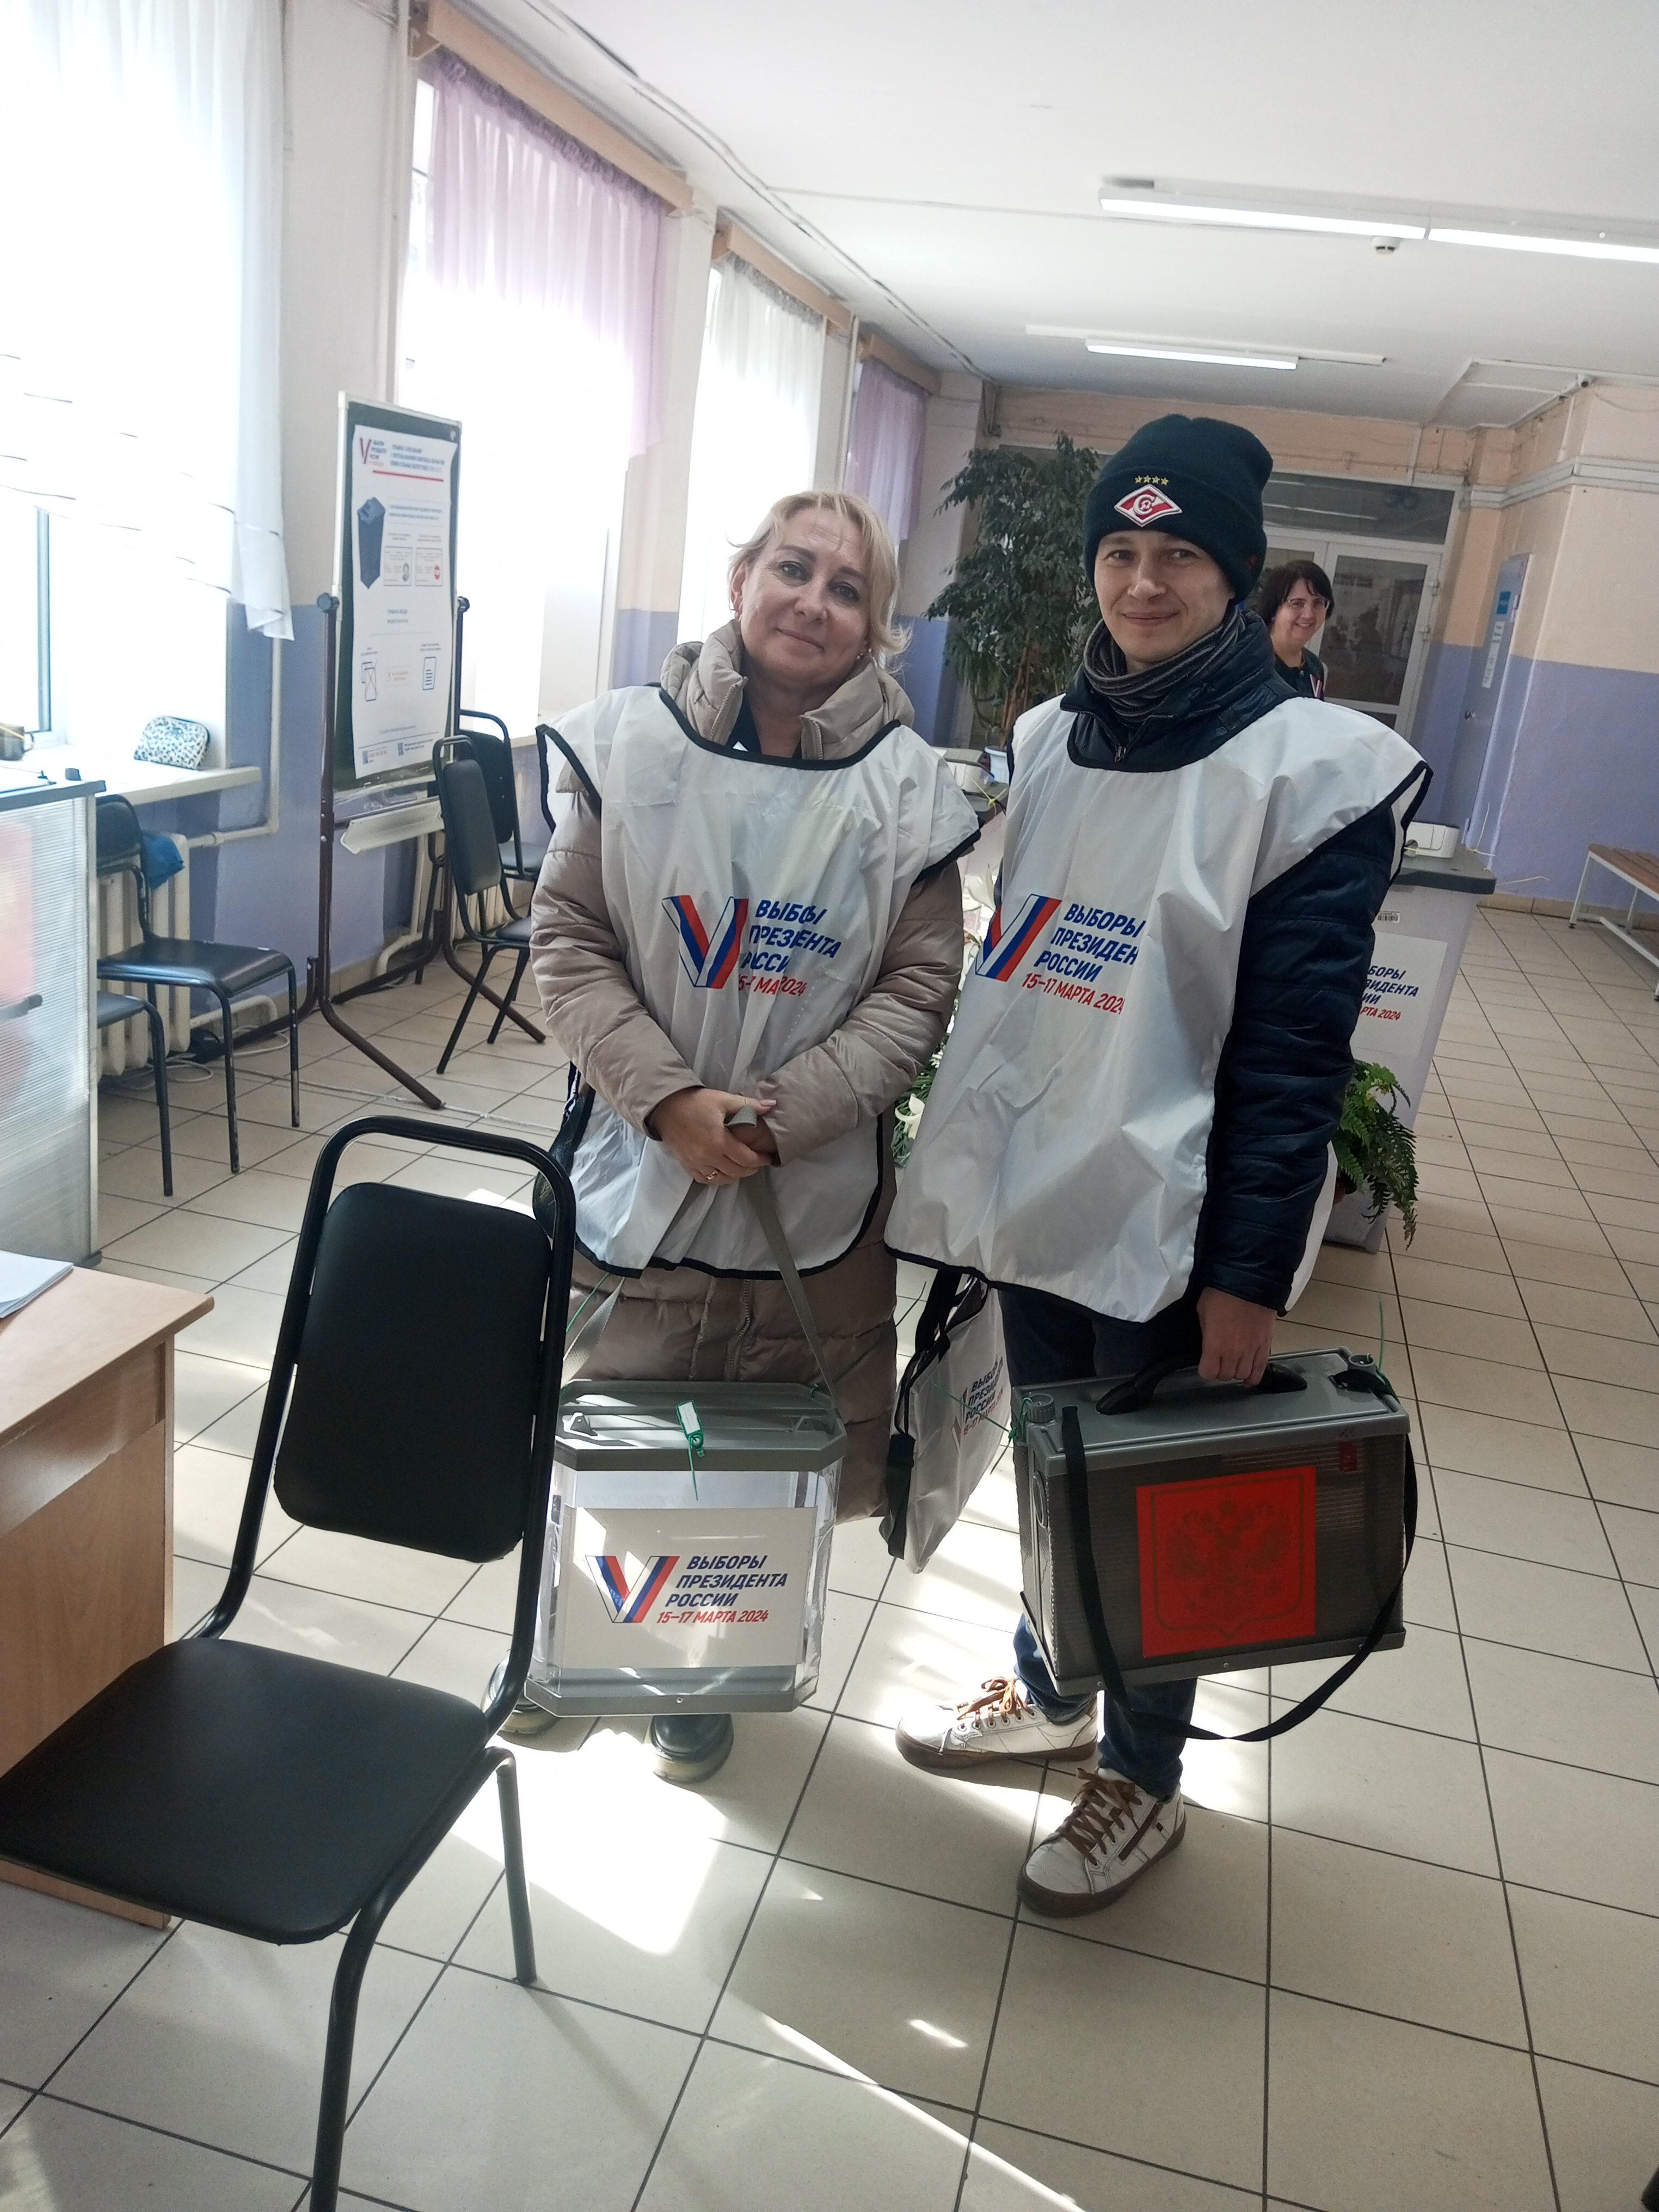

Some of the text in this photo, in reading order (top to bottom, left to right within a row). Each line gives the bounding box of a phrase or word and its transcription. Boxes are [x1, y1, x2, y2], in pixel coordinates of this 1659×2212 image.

[1064, 903, 1146, 938] ВЫБОРЫ
[749, 925, 842, 958] ПРЕЗЕНТА
[1050, 927, 1139, 965] ПРЕЗИДЕН
[1034, 950, 1103, 982] РОССИИ
[1367, 966, 1406, 980] БОРЫ
[1054, 981, 1096, 1006] МАРТА
[1366, 979, 1419, 997] ЗИДЕНТА
[1360, 1006, 1401, 1021] РТА 2024
[971, 1354, 998, 1392] ВЫБО
[686, 1555, 768, 1569] ВЫБОРЫ
[675, 1573, 788, 1590] ПРЕЗИДЕНТА
[665, 1593, 739, 1607] РОССИИ
[693, 1610, 738, 1624] МАРТА
[736, 1609, 770, 1623] 2024
